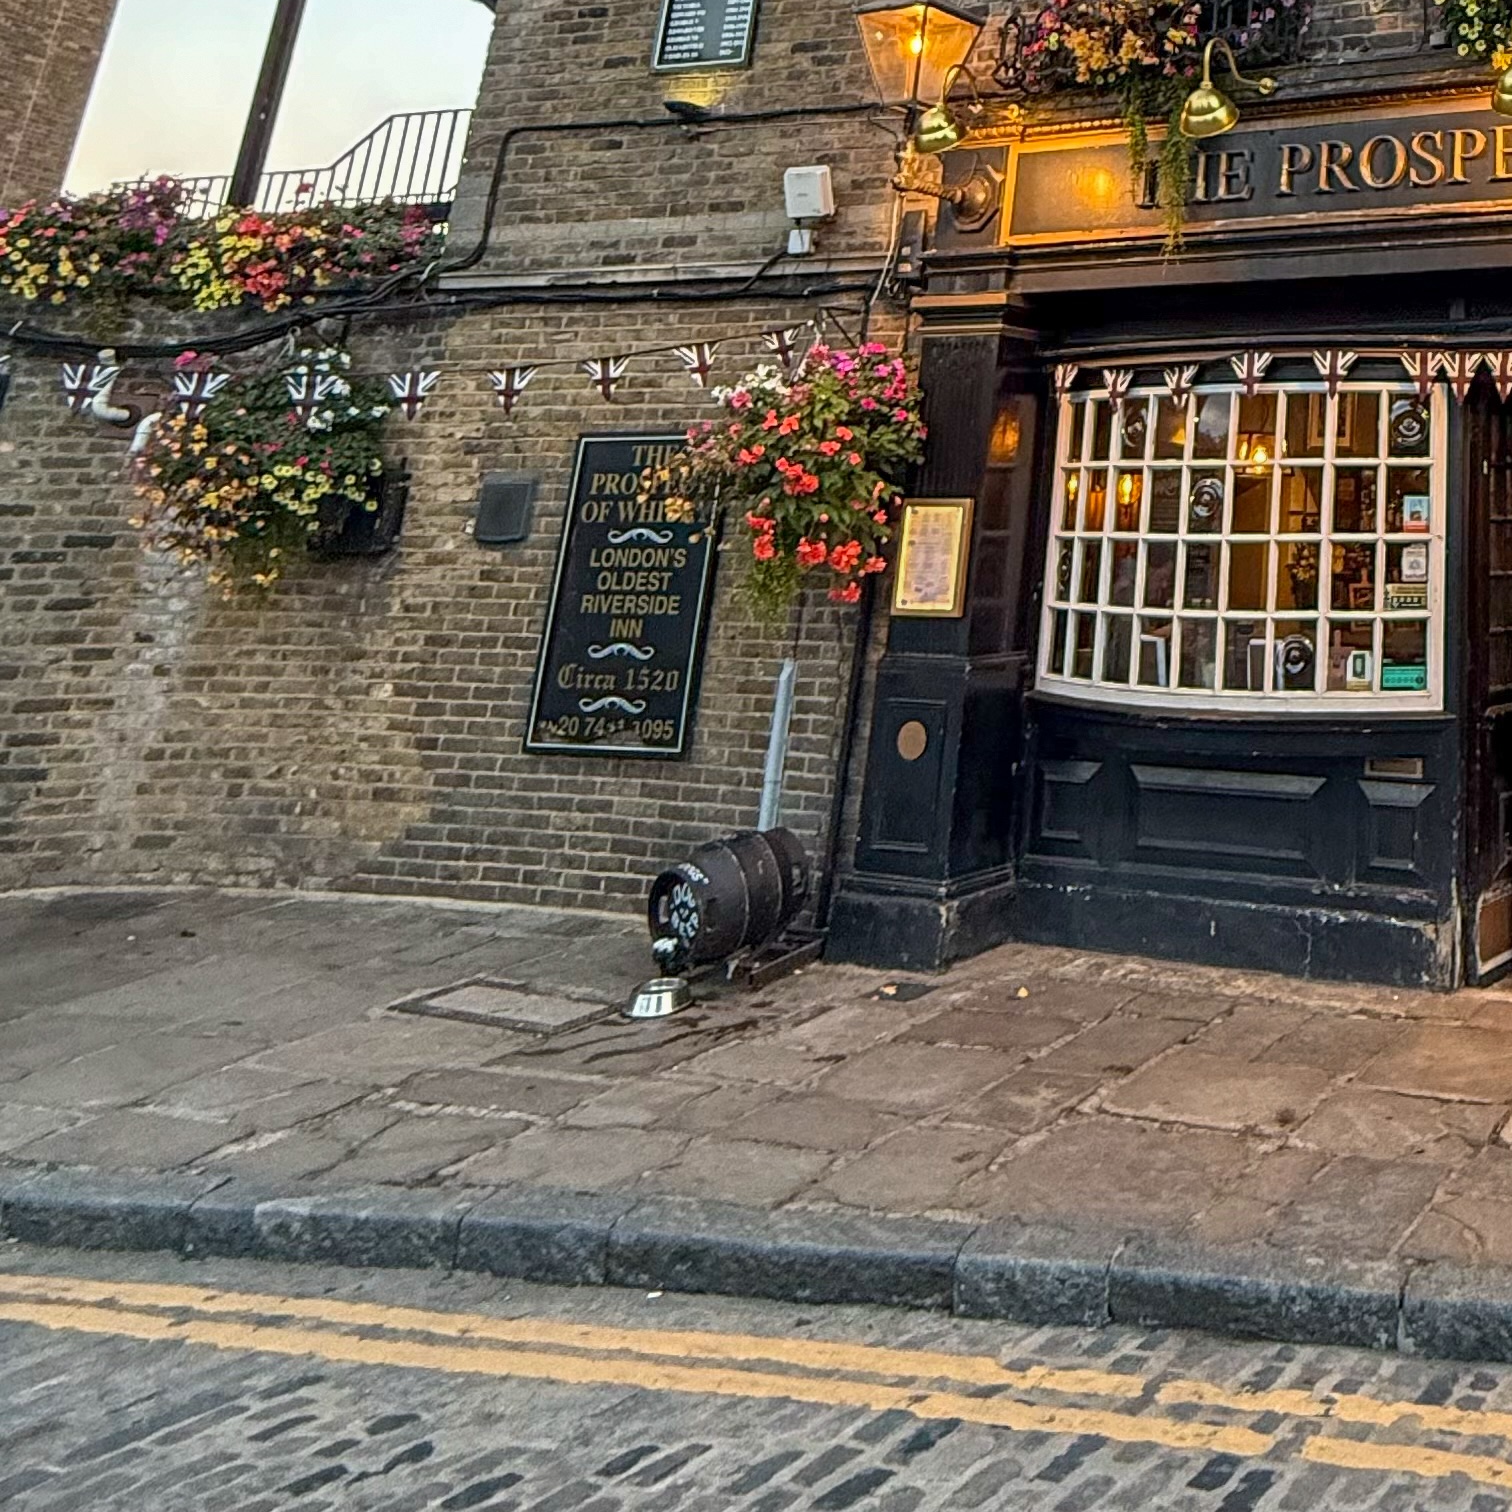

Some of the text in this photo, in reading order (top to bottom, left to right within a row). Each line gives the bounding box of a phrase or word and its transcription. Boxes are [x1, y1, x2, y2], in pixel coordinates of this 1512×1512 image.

[631, 445, 679, 467] THE
[581, 500, 711, 524] OF WHIY
[589, 548, 687, 569] LONDON'S
[597, 571, 673, 592] OLDEST
[580, 594, 681, 615] RIVERSIDE
[609, 619, 643, 638] INN
[558, 663, 680, 691] Circa 1520
[540, 715, 580, 737] 20
